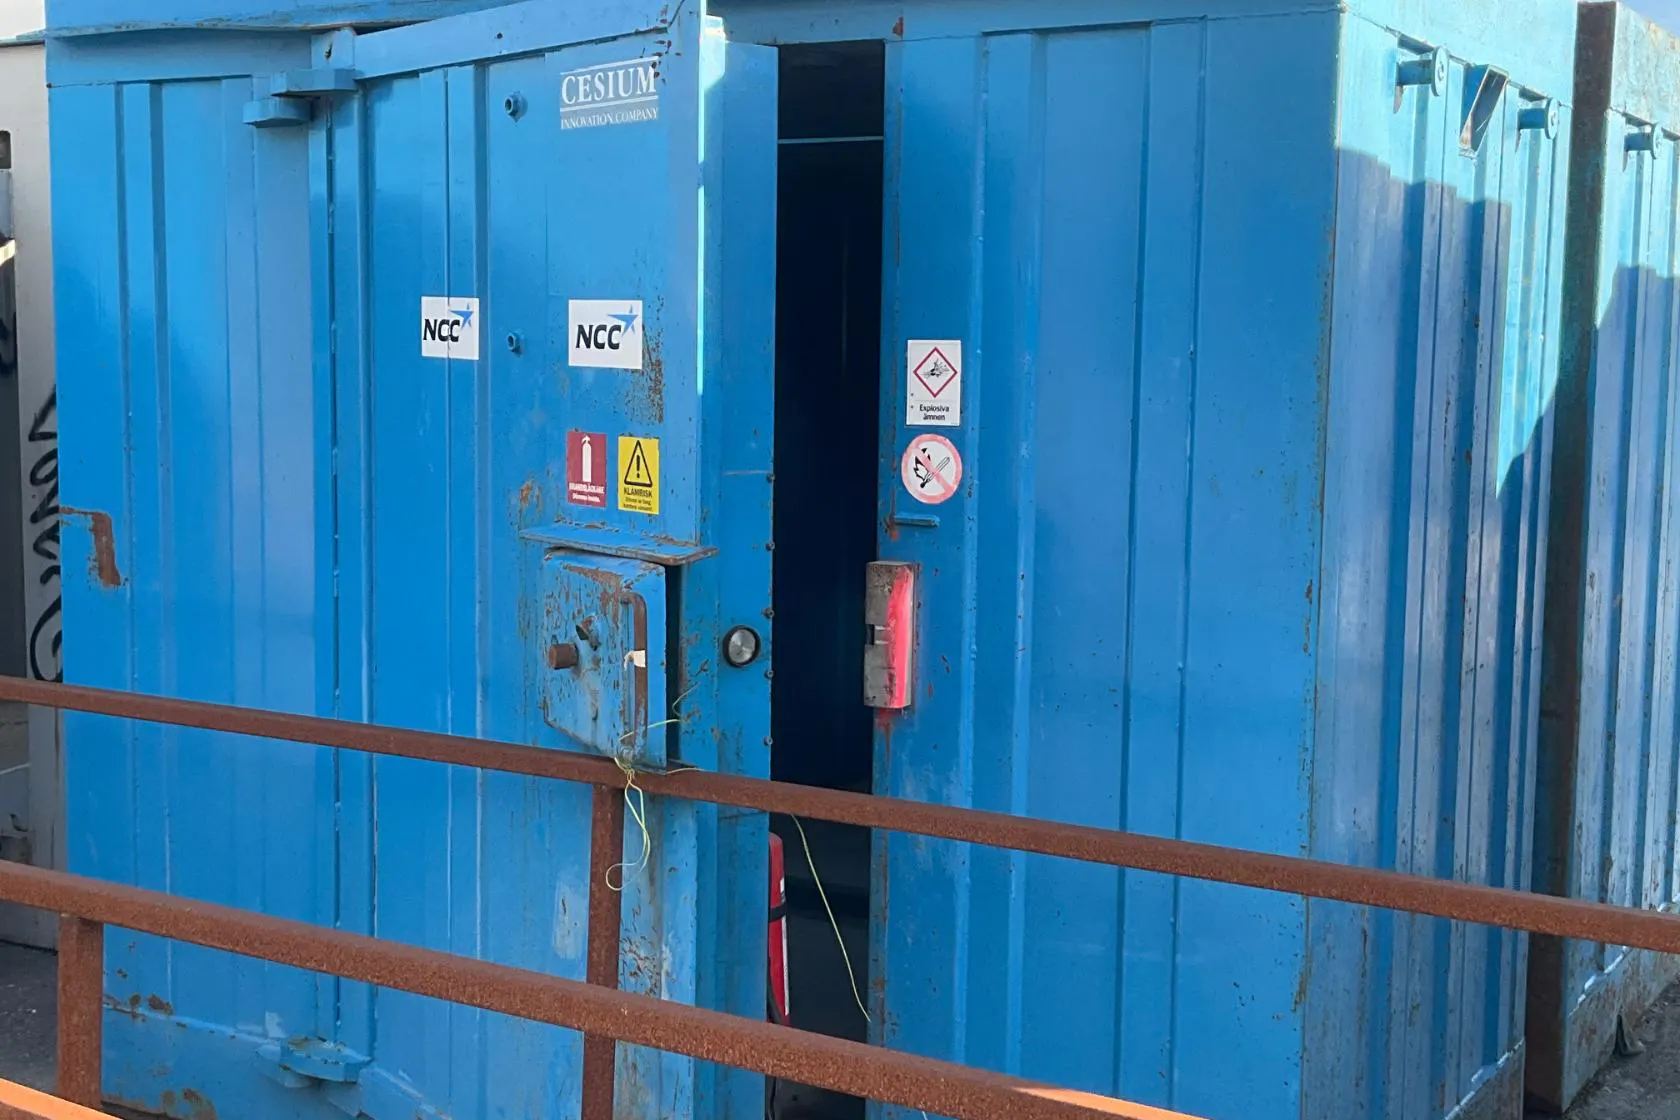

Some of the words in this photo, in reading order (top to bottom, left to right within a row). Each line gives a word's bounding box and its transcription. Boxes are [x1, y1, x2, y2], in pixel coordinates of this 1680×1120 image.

[562, 66, 656, 104] CESIUM
[561, 113, 613, 129] INNOVATION
[615, 107, 657, 123] COMPANY
[423, 319, 460, 342] NCC
[576, 324, 622, 350] NCC
[919, 404, 949, 412] Explosiva
